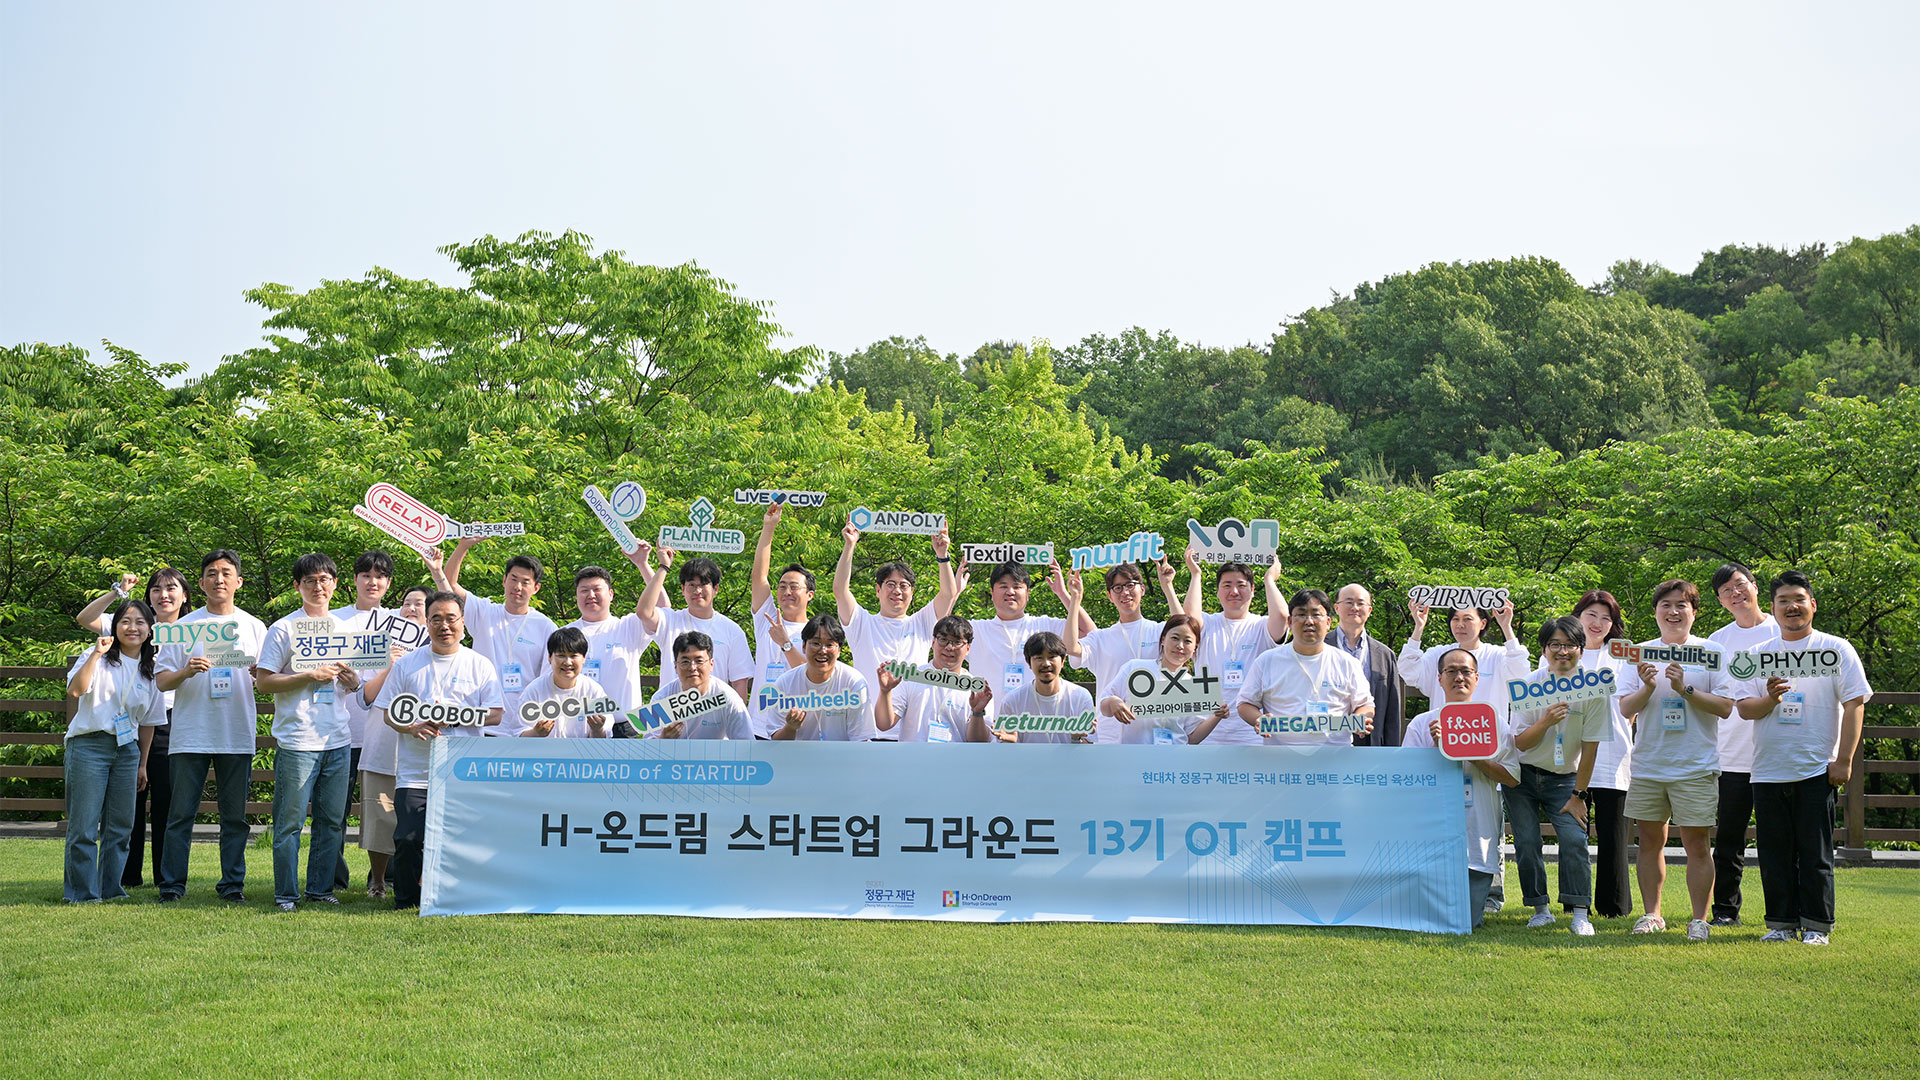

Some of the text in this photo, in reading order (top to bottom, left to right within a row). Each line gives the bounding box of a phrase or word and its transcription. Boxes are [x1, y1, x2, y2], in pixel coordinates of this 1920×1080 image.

[735, 491, 825, 506] LIVE COW
[378, 494, 436, 532] RELAY
[585, 488, 634, 553] DolbomDream
[874, 512, 943, 528] ANPOLY
[355, 507, 434, 557] BRAND RESALE SOLUTION
[463, 523, 523, 536] 한국주택정보
[662, 527, 741, 544] PLANTNER
[1072, 533, 1164, 569] nurfit
[1206, 552, 1226, 562] 위한
[1409, 587, 1507, 609] PAIRINGS
[295, 620, 331, 634] 현대차
[152, 622, 238, 653] mysc
[295, 636, 348, 657] 정몽구
[353, 634, 388, 655] 재단
[1611, 642, 1719, 669] Big mobility
[1760, 650, 1838, 669] PHYTO
[1760, 669, 1838, 677] RESEARCH
[1508, 668, 1614, 702] Dadadoc
[669, 690, 699, 709] ECO
[673, 692, 727, 721] MARINE
[759, 686, 860, 711] Pinwheels
[1129, 701, 1221, 716] (주)우리아이들플러스
[1514, 686, 1615, 711] HEALTHCARE
[418, 704, 488, 725] COBOT
[994, 711, 1095, 732] returnall
[1260, 715, 1364, 733] MEGAPLAN
[1447, 732, 1492, 745] DONE
[467, 761, 757, 781] A NEW STANDARD of STARTUP
[1142, 771, 1437, 787] 현대차 정몽구 재단의 국내 대표 임팩트 스타트업 육성사업
[541, 811, 1346, 862] H-온드림 스타트업 그라운드 13기 OT 캠프
[865, 889, 916, 901] 정몽구 재단
